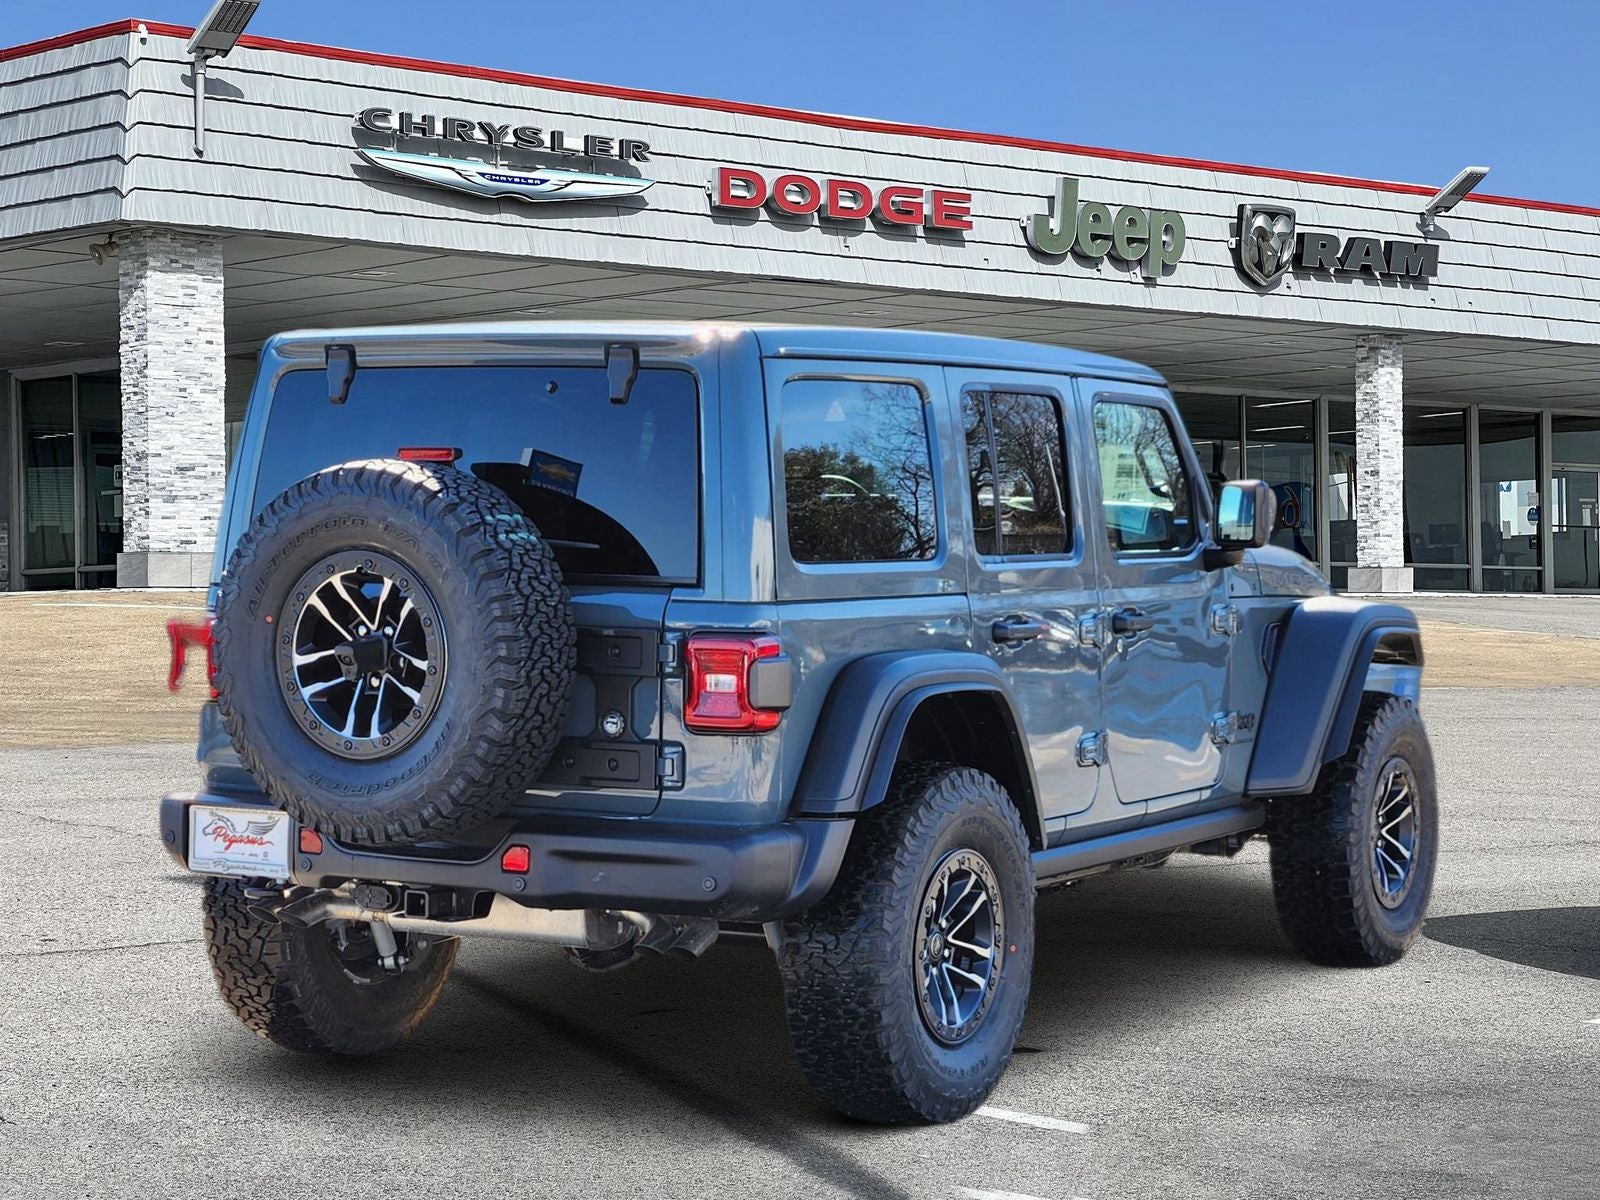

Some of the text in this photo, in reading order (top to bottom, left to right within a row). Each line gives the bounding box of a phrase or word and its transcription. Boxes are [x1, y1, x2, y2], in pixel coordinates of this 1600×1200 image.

[358, 107, 651, 162] CHRYSLER
[483, 173, 542, 186] CHRYSLER
[712, 167, 974, 231] DODGE
[1026, 177, 1186, 278] Jeep
[1297, 232, 1439, 278] RAM
[212, 825, 275, 851] Pegasus
